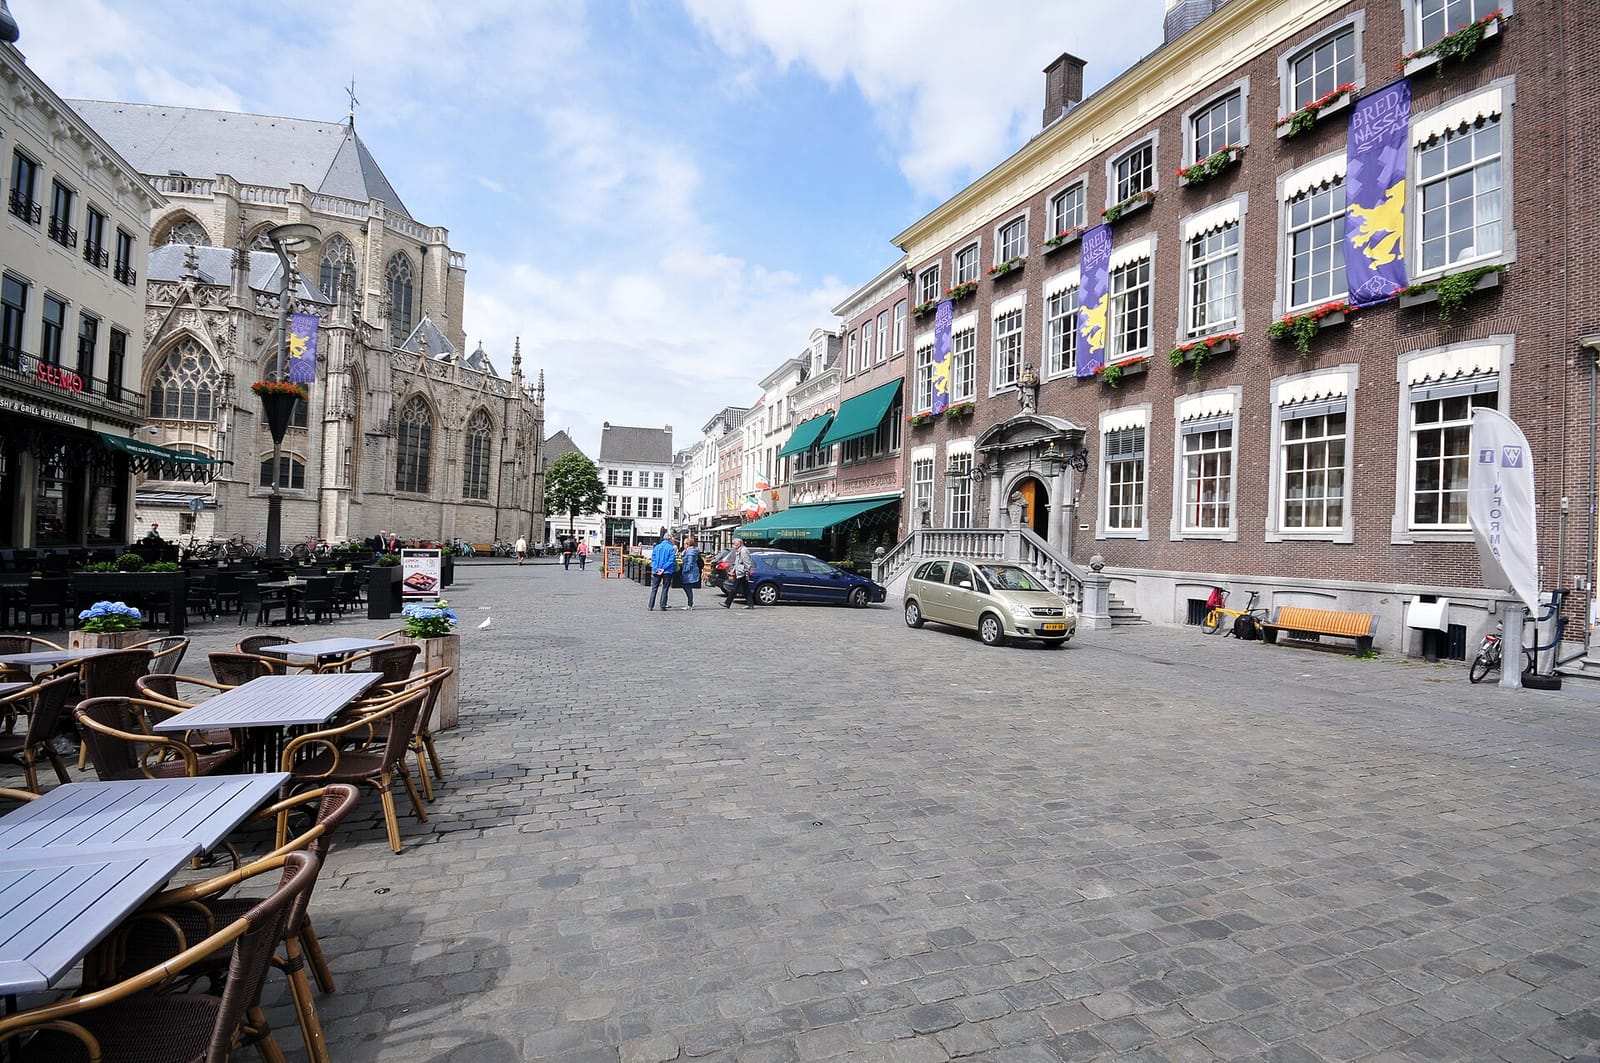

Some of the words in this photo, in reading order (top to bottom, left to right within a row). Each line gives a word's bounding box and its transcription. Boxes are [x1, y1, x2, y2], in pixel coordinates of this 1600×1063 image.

[1352, 83, 1411, 130] BREDA
[38, 361, 83, 393] SUMO
[14, 401, 18, 410] &
[20, 403, 39, 416] GRILL
[40, 408, 77, 425] RESTAURANT
